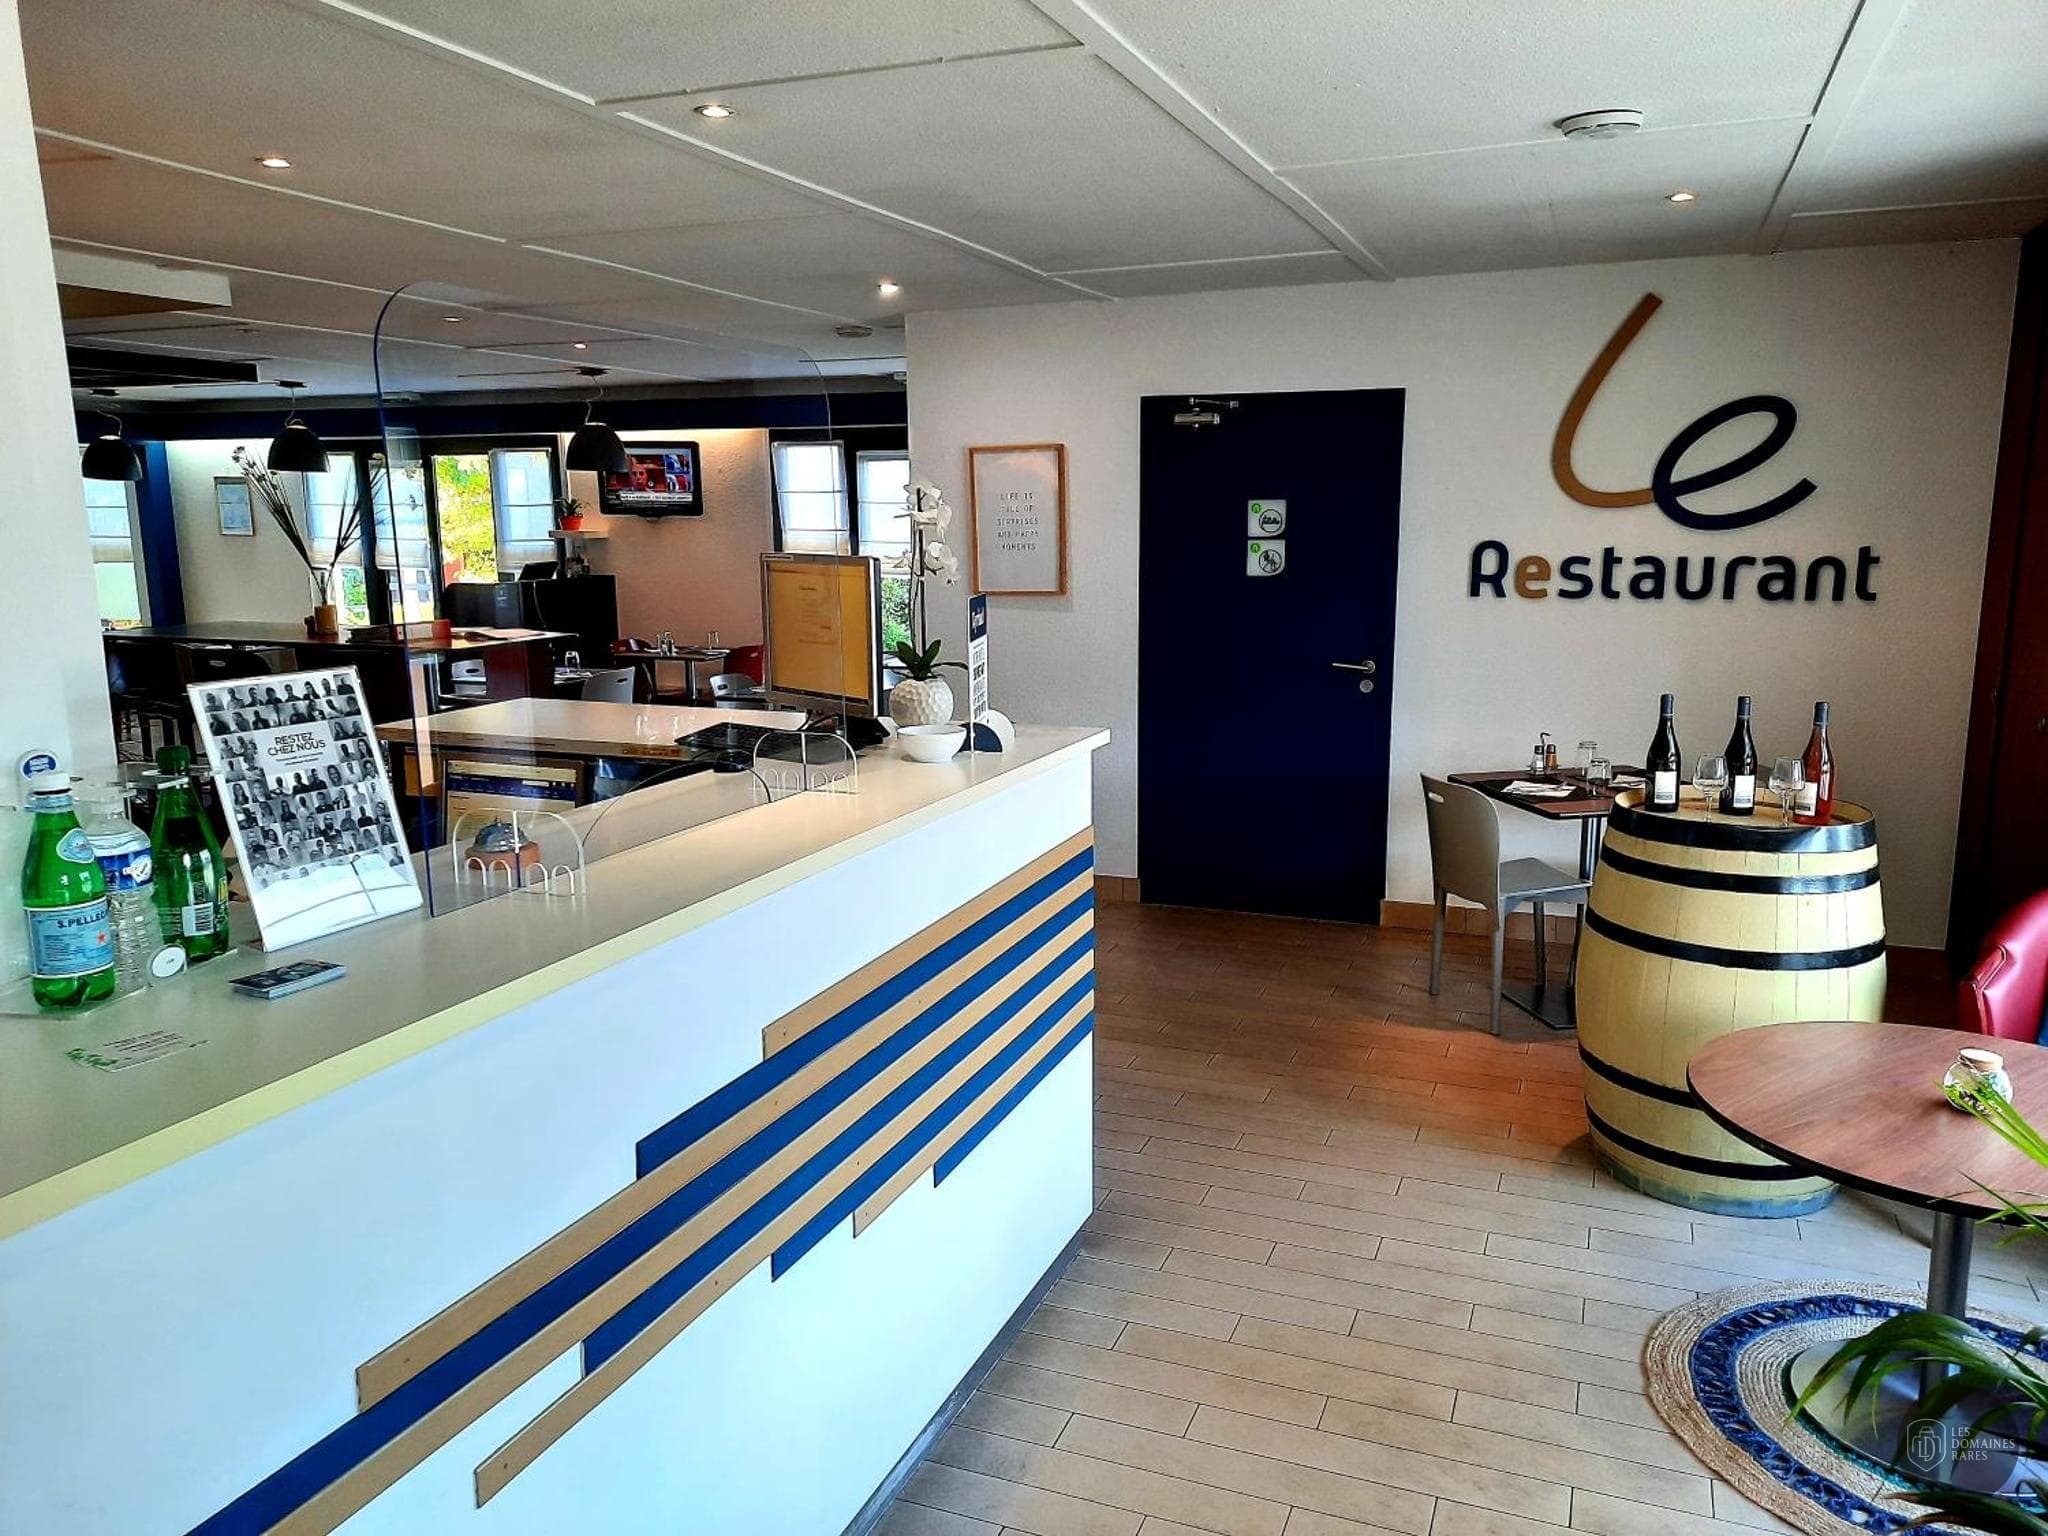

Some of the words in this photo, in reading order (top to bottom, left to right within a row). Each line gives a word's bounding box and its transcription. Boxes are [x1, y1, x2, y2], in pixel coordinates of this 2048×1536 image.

[1470, 540, 1880, 601] Restaurant
[274, 732, 315, 745] RESTEZ
[267, 743, 295, 756] CHEZ
[296, 739, 326, 752] NOUS
